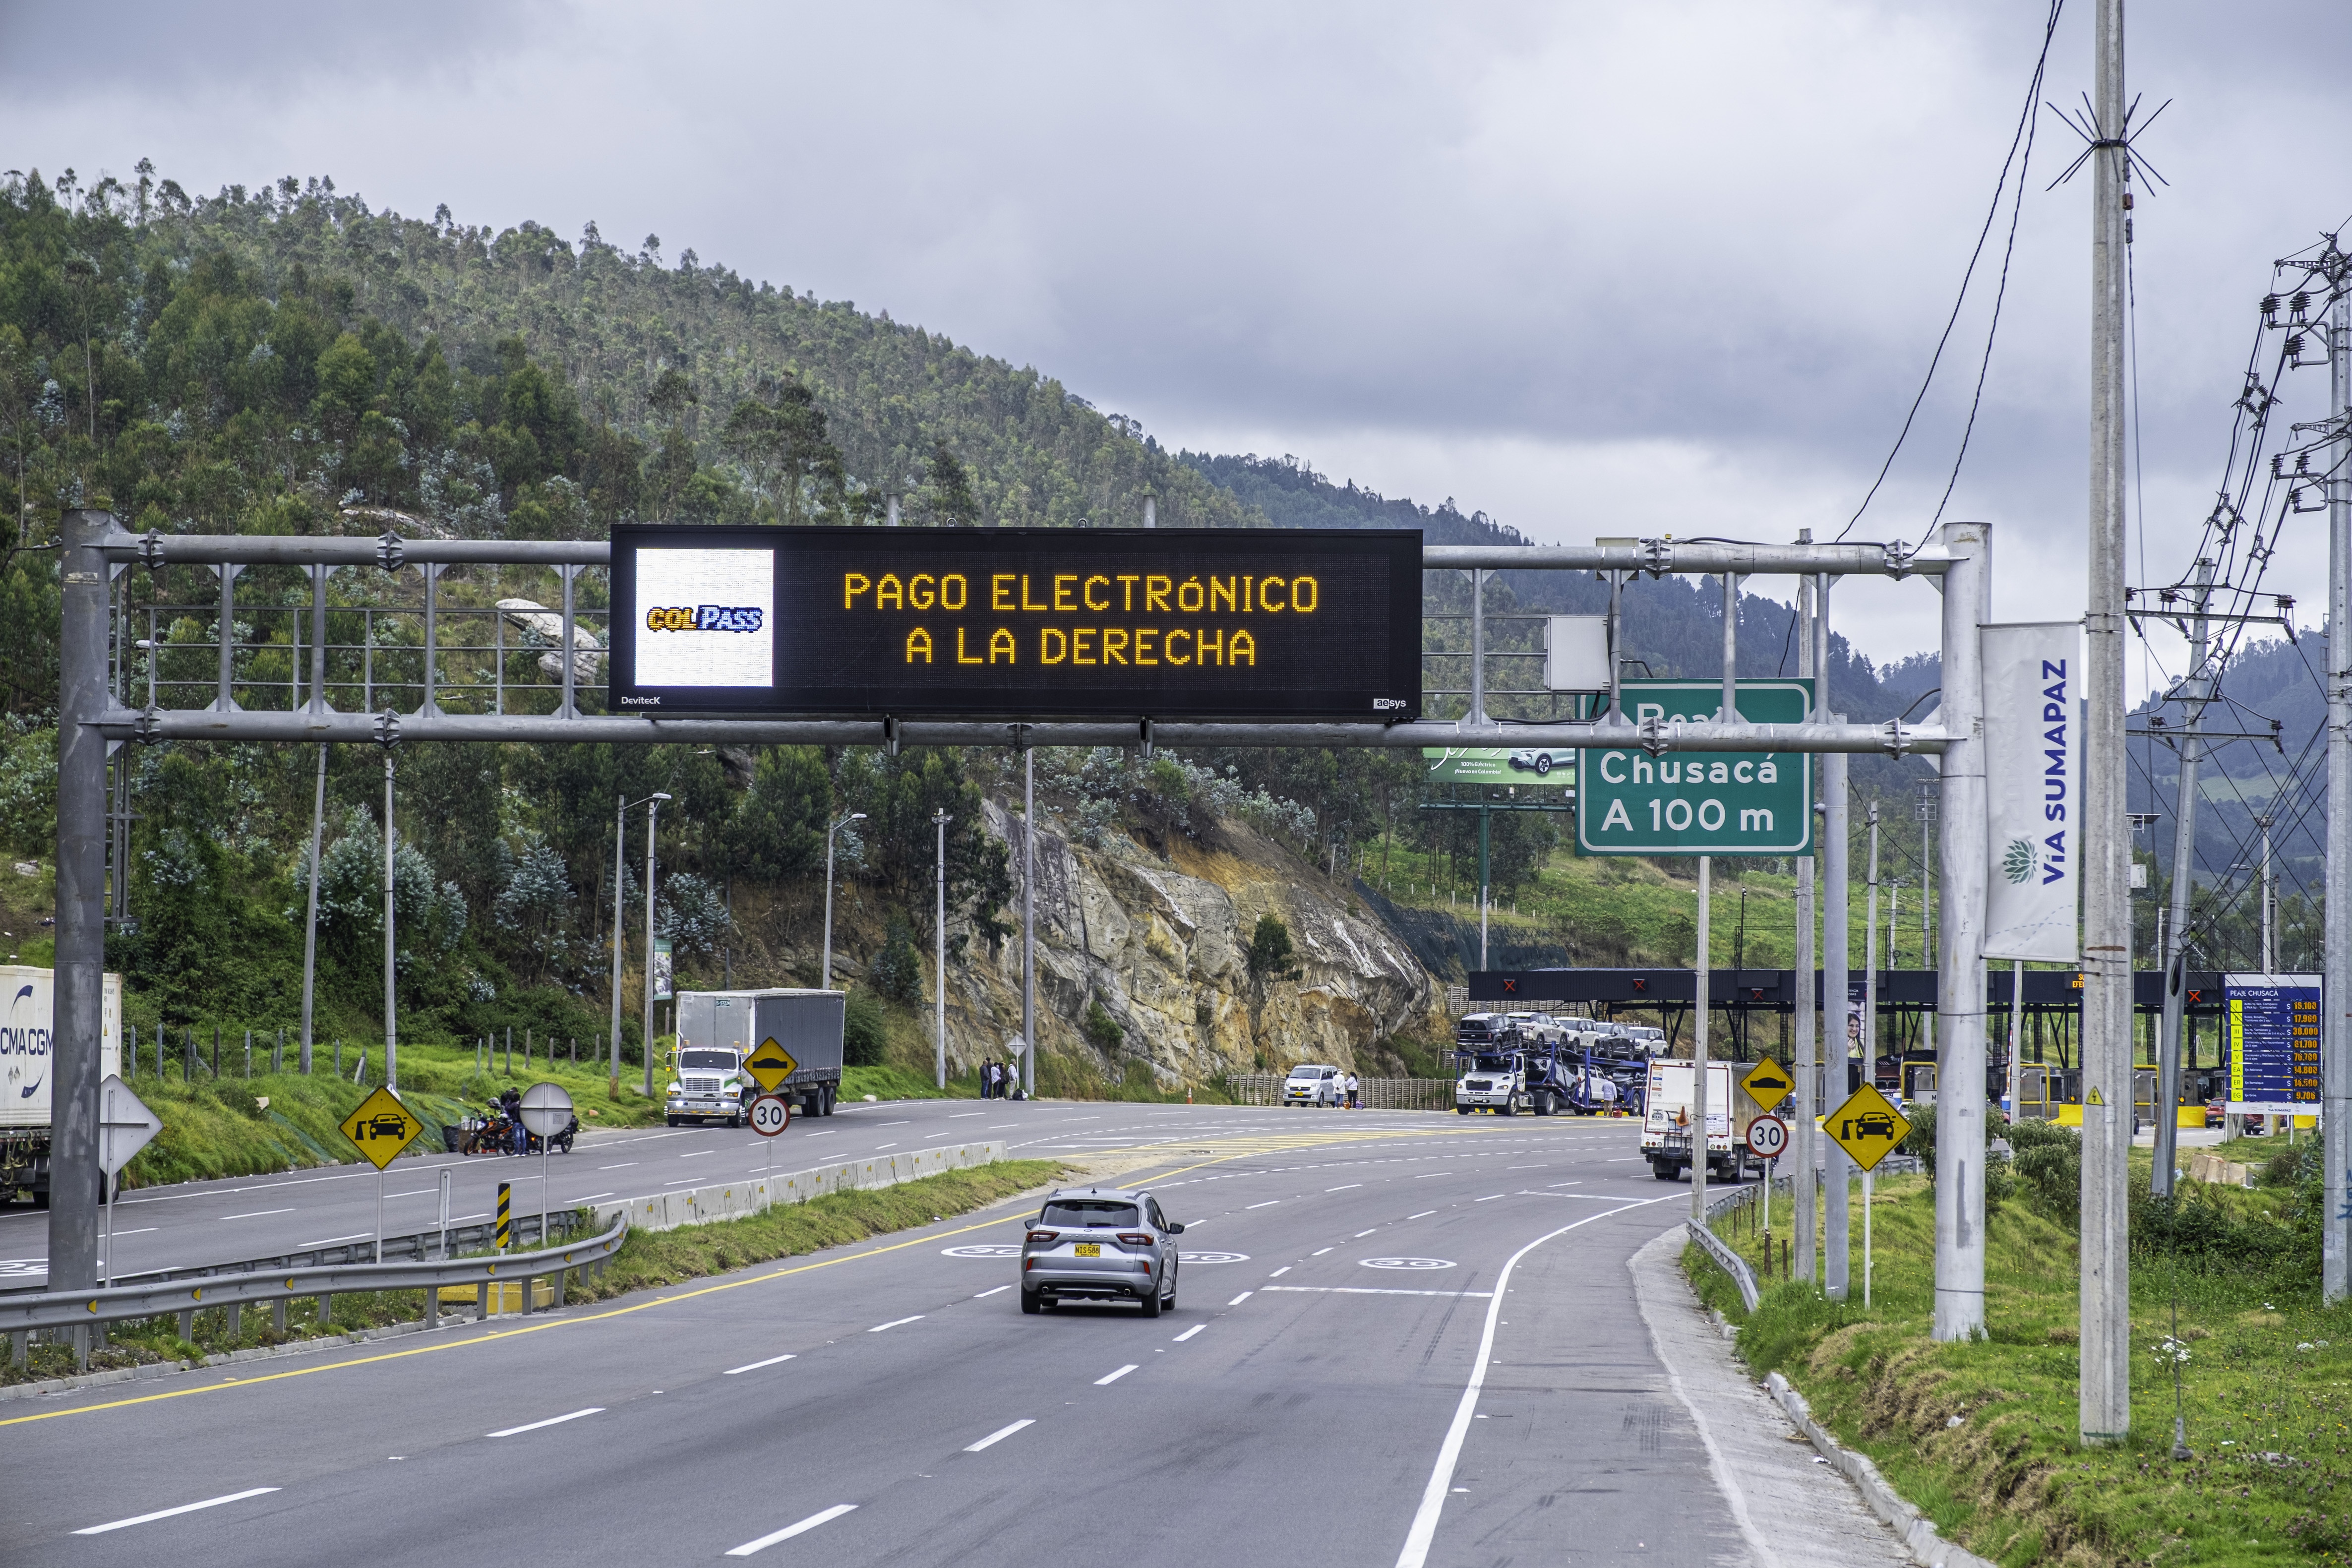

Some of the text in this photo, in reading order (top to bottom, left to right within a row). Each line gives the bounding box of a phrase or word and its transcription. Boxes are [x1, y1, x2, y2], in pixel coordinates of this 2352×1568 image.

[844, 574, 1317, 612] PAGO ELECTRÓNICO
[906, 627, 1255, 665] A LA DERECHA
[1377, 700, 1406, 709] aesys
[2042, 659, 2066, 822] SUMAPAZ
[1601, 751, 1777, 784] Chusacá
[1602, 799, 1773, 831] A 100 m
[0, 1027, 53, 1055] CMA CGM
[2296, 1091, 2315, 1100] 9.700
[757, 1106, 782, 1125] 30
[1754, 1126, 1780, 1146] 30
